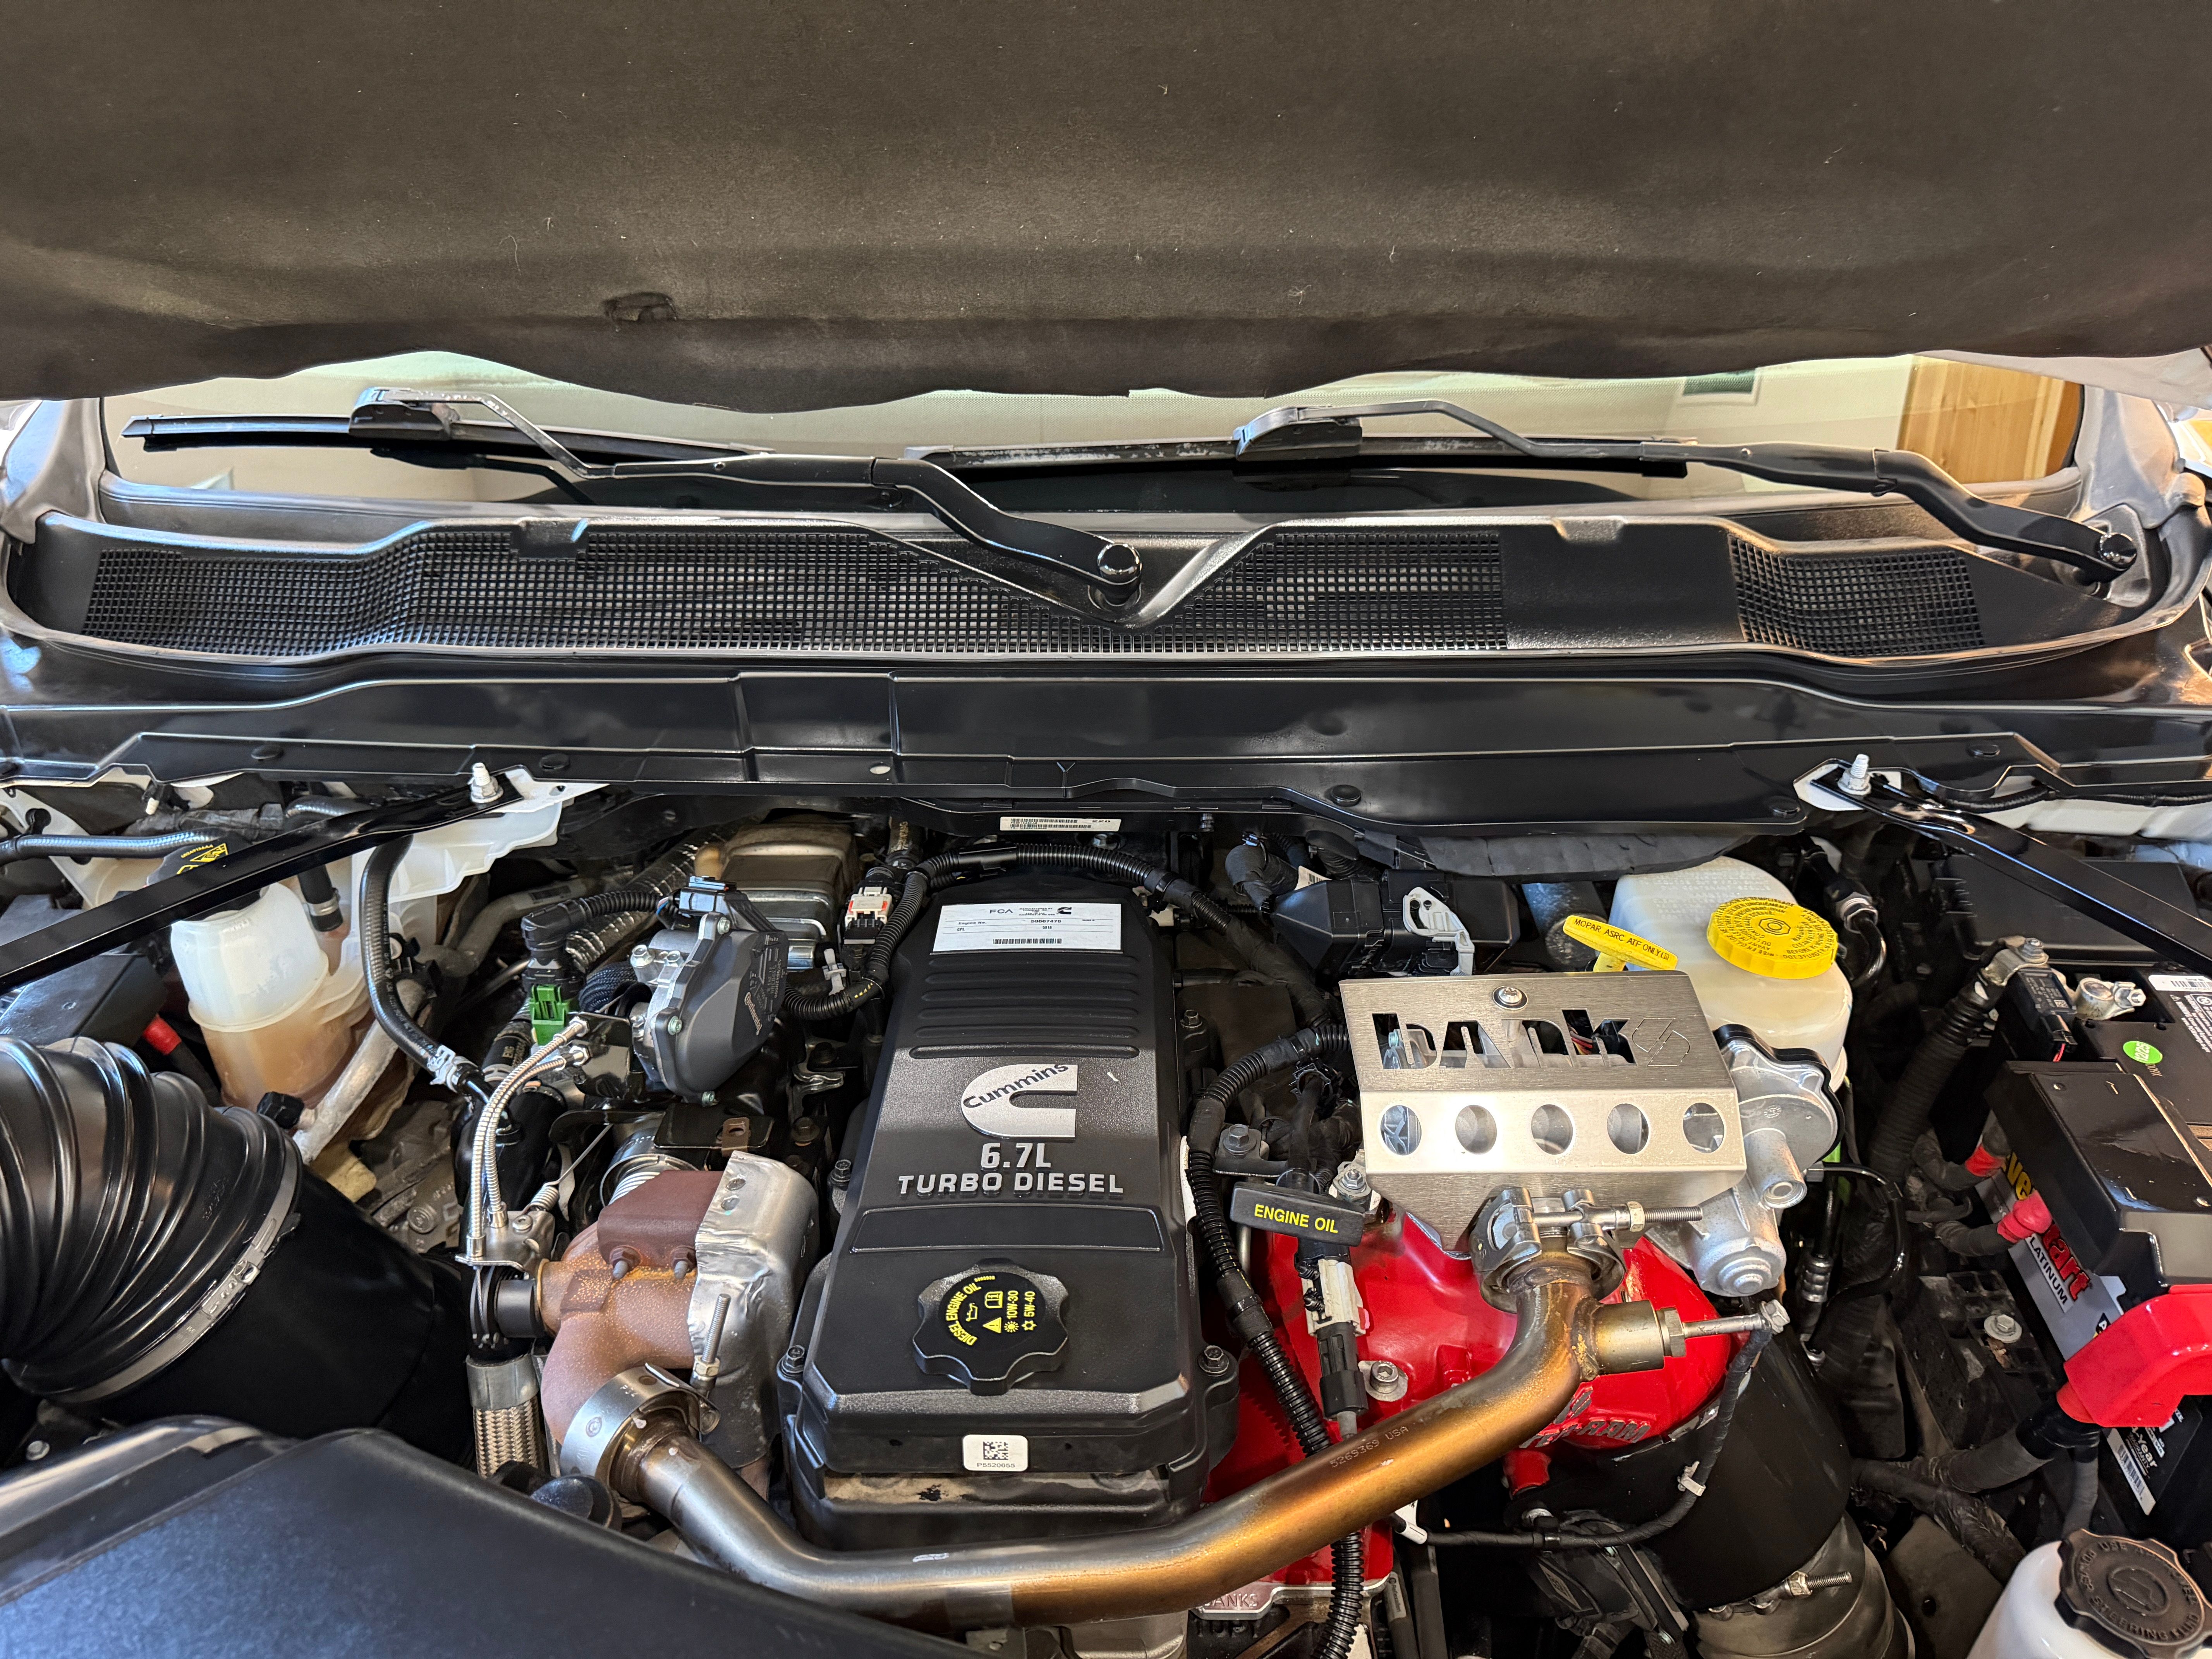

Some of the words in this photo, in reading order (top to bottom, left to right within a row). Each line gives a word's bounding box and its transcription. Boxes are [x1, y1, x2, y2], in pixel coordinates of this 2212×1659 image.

[1574, 919, 1601, 932] MOPAR
[1604, 929, 1624, 941] ASRC
[1626, 938, 1642, 947] ATF
[1643, 944, 1661, 956] ONLY
[744, 992, 763, 1035] Continental
[2134, 1041, 2150, 1061] 12/25
[963, 1063, 1069, 1108] Cummins
[981, 1143, 1051, 1168] 6.7L
[898, 1173, 1003, 1195] TURBO
[1014, 1173, 1123, 1194] DIESEL
[1254, 1204, 1310, 1228] ENGINE
[1315, 1217, 1338, 1233] OIL
[2029, 1236, 2068, 1305] LATINUM
[963, 1283, 982, 1294] OIL
[946, 1291, 967, 1321] ENGINE
[1008, 1290, 1019, 1319] 10W-30
[1024, 1291, 1036, 1317] 5W-40
[948, 1321, 978, 1346] DIESEL
[1385, 1426, 1409, 1440] USA
[2098, 1540, 2130, 1554] USE
[1205, 1593, 1258, 1607] ANKS
[2087, 1595, 2171, 1641] STEERING
